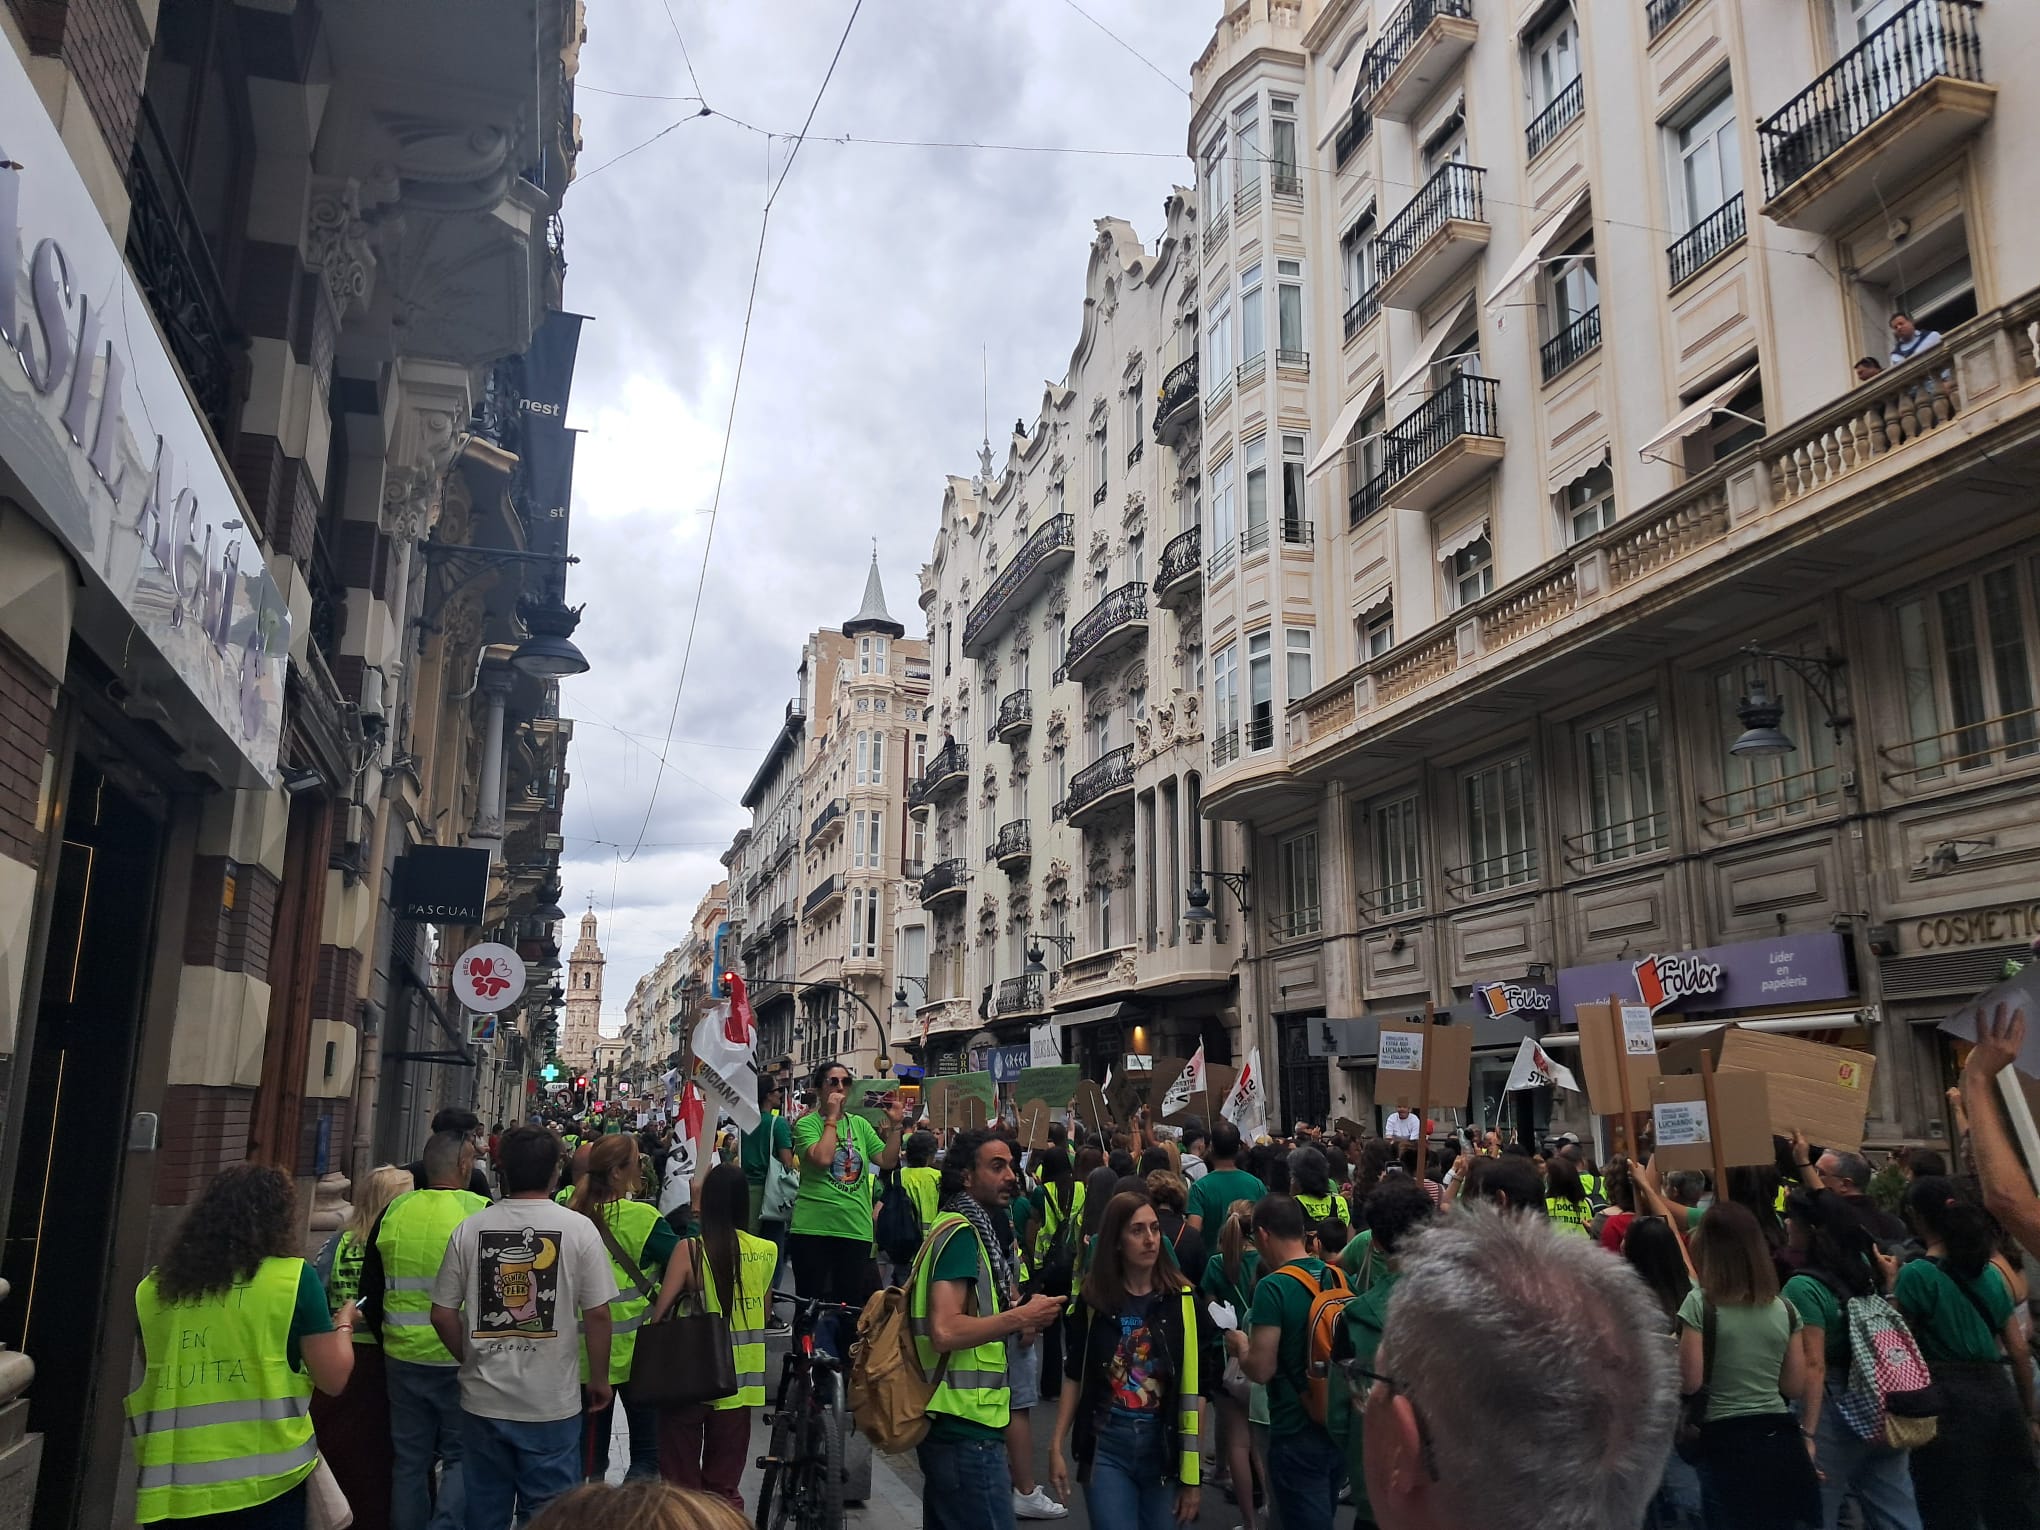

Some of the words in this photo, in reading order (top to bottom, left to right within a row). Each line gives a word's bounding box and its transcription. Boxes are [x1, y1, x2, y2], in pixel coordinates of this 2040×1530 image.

[519, 398, 560, 416] nest
[549, 507, 565, 518] st
[408, 904, 477, 918] PASCUAL
[1654, 957, 1717, 995] Folder
[1776, 966, 1790, 976] en
[1503, 987, 1551, 1008] Folder
[1005, 1051, 1028, 1069] GREEK
[506, 1286, 526, 1294] PERK
[182, 1326, 209, 1349] EN
